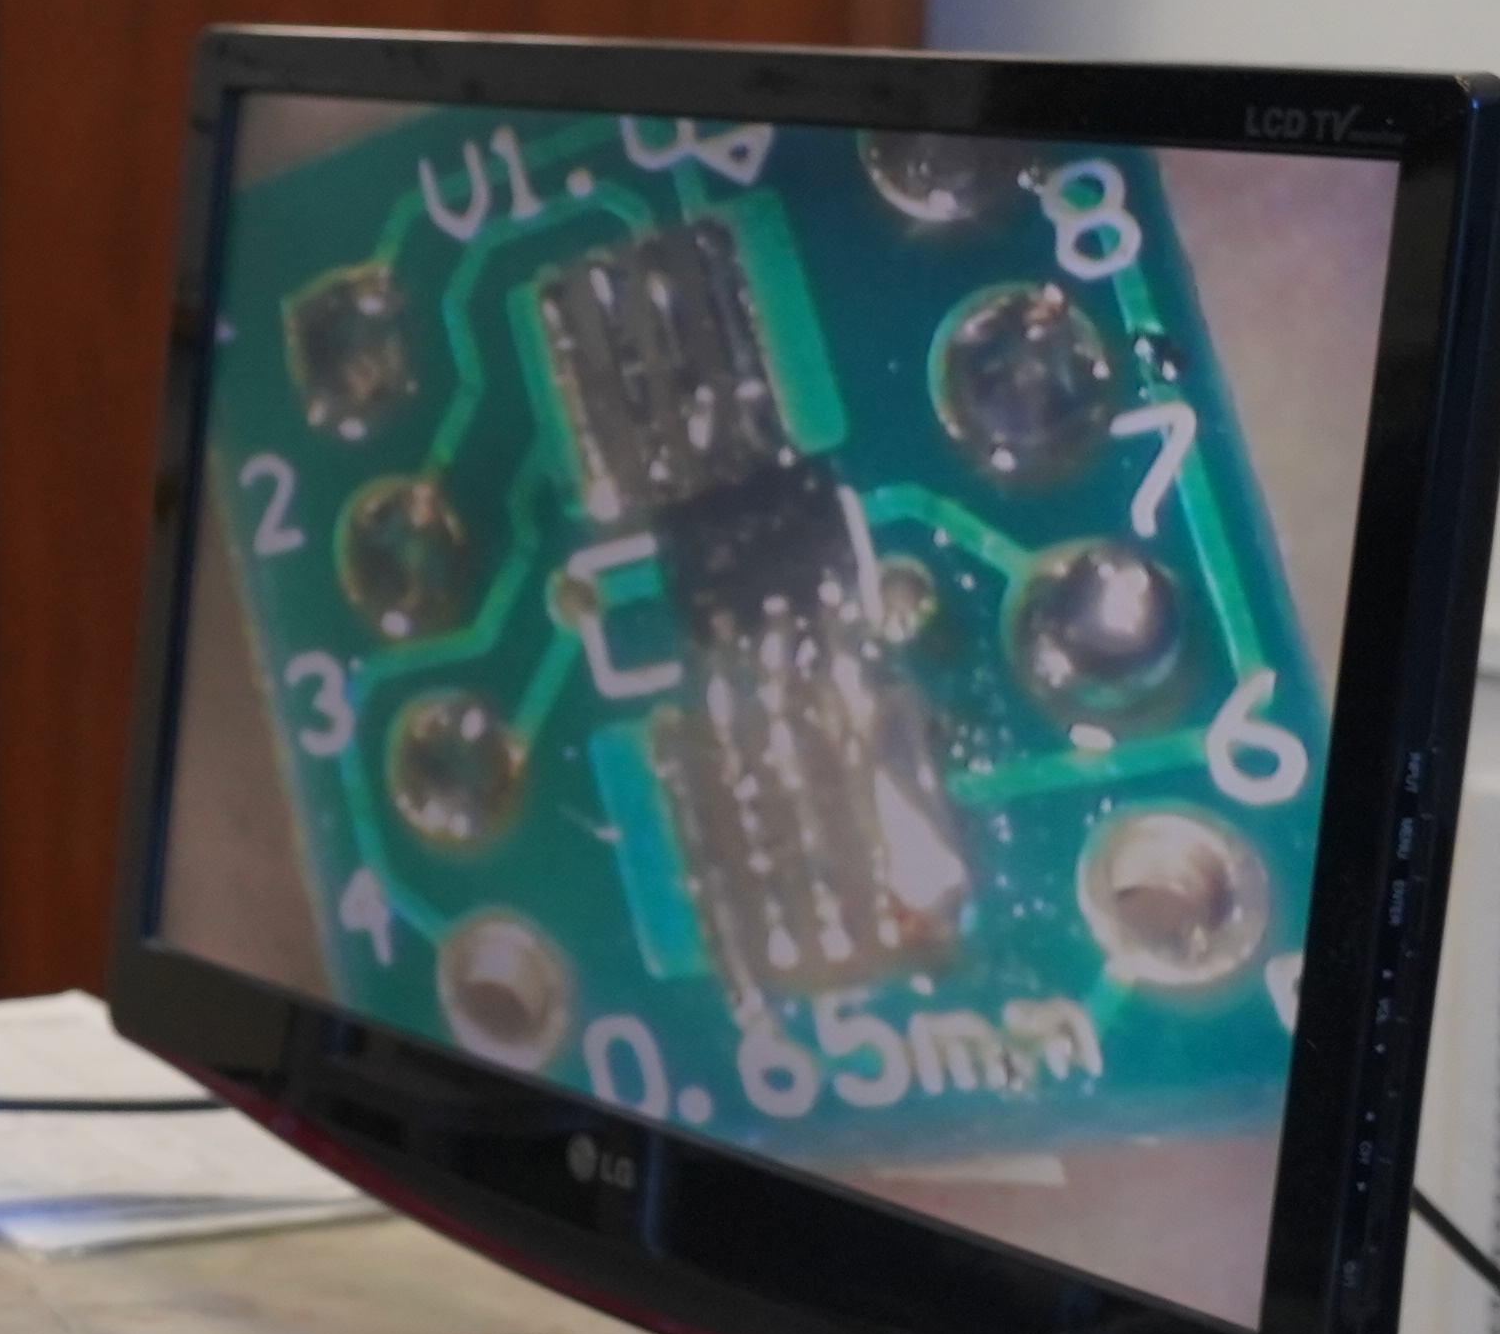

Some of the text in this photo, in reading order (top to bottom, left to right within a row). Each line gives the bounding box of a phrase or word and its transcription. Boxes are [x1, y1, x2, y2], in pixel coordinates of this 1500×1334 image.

[1246, 103, 1363, 142] LCD TV
[1039, 158, 1142, 280] 8
[240, 452, 306, 557] 2
[1109, 400, 1198, 538] 7
[284, 650, 357, 756] 3
[1206, 667, 1309, 807] 6
[339, 865, 393, 968] 4
